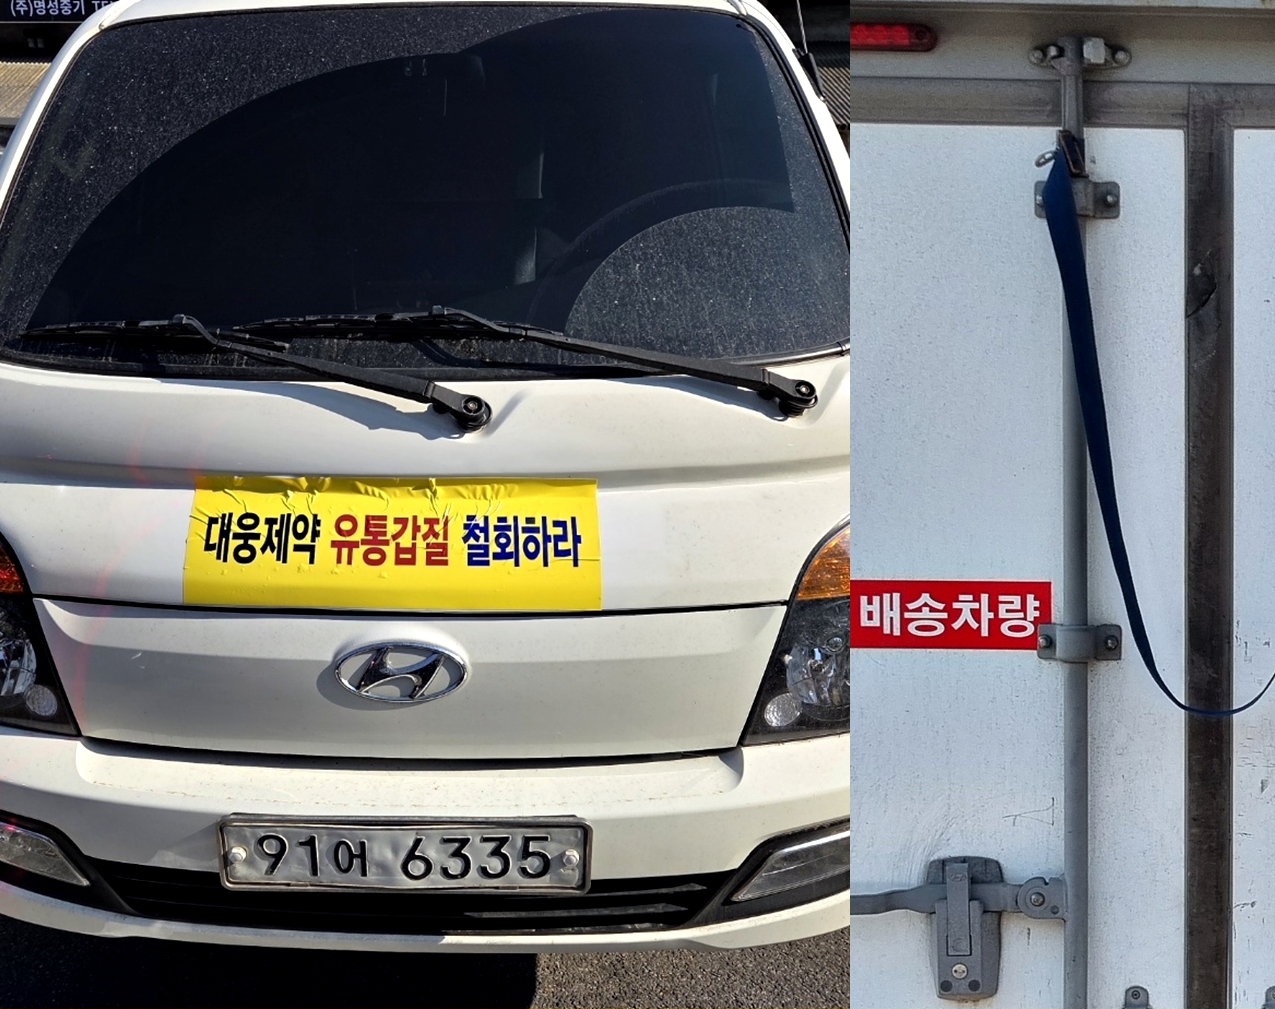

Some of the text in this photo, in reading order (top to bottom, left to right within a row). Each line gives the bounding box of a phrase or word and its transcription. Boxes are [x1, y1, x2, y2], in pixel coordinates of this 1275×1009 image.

[10, 0, 85, 17] (주)명성중기
[203, 512, 582, 568] 대웅제약 유통갑질 철회하라
[860, 592, 1040, 638] 배송차량
[255, 834, 552, 880] 91어 6335
